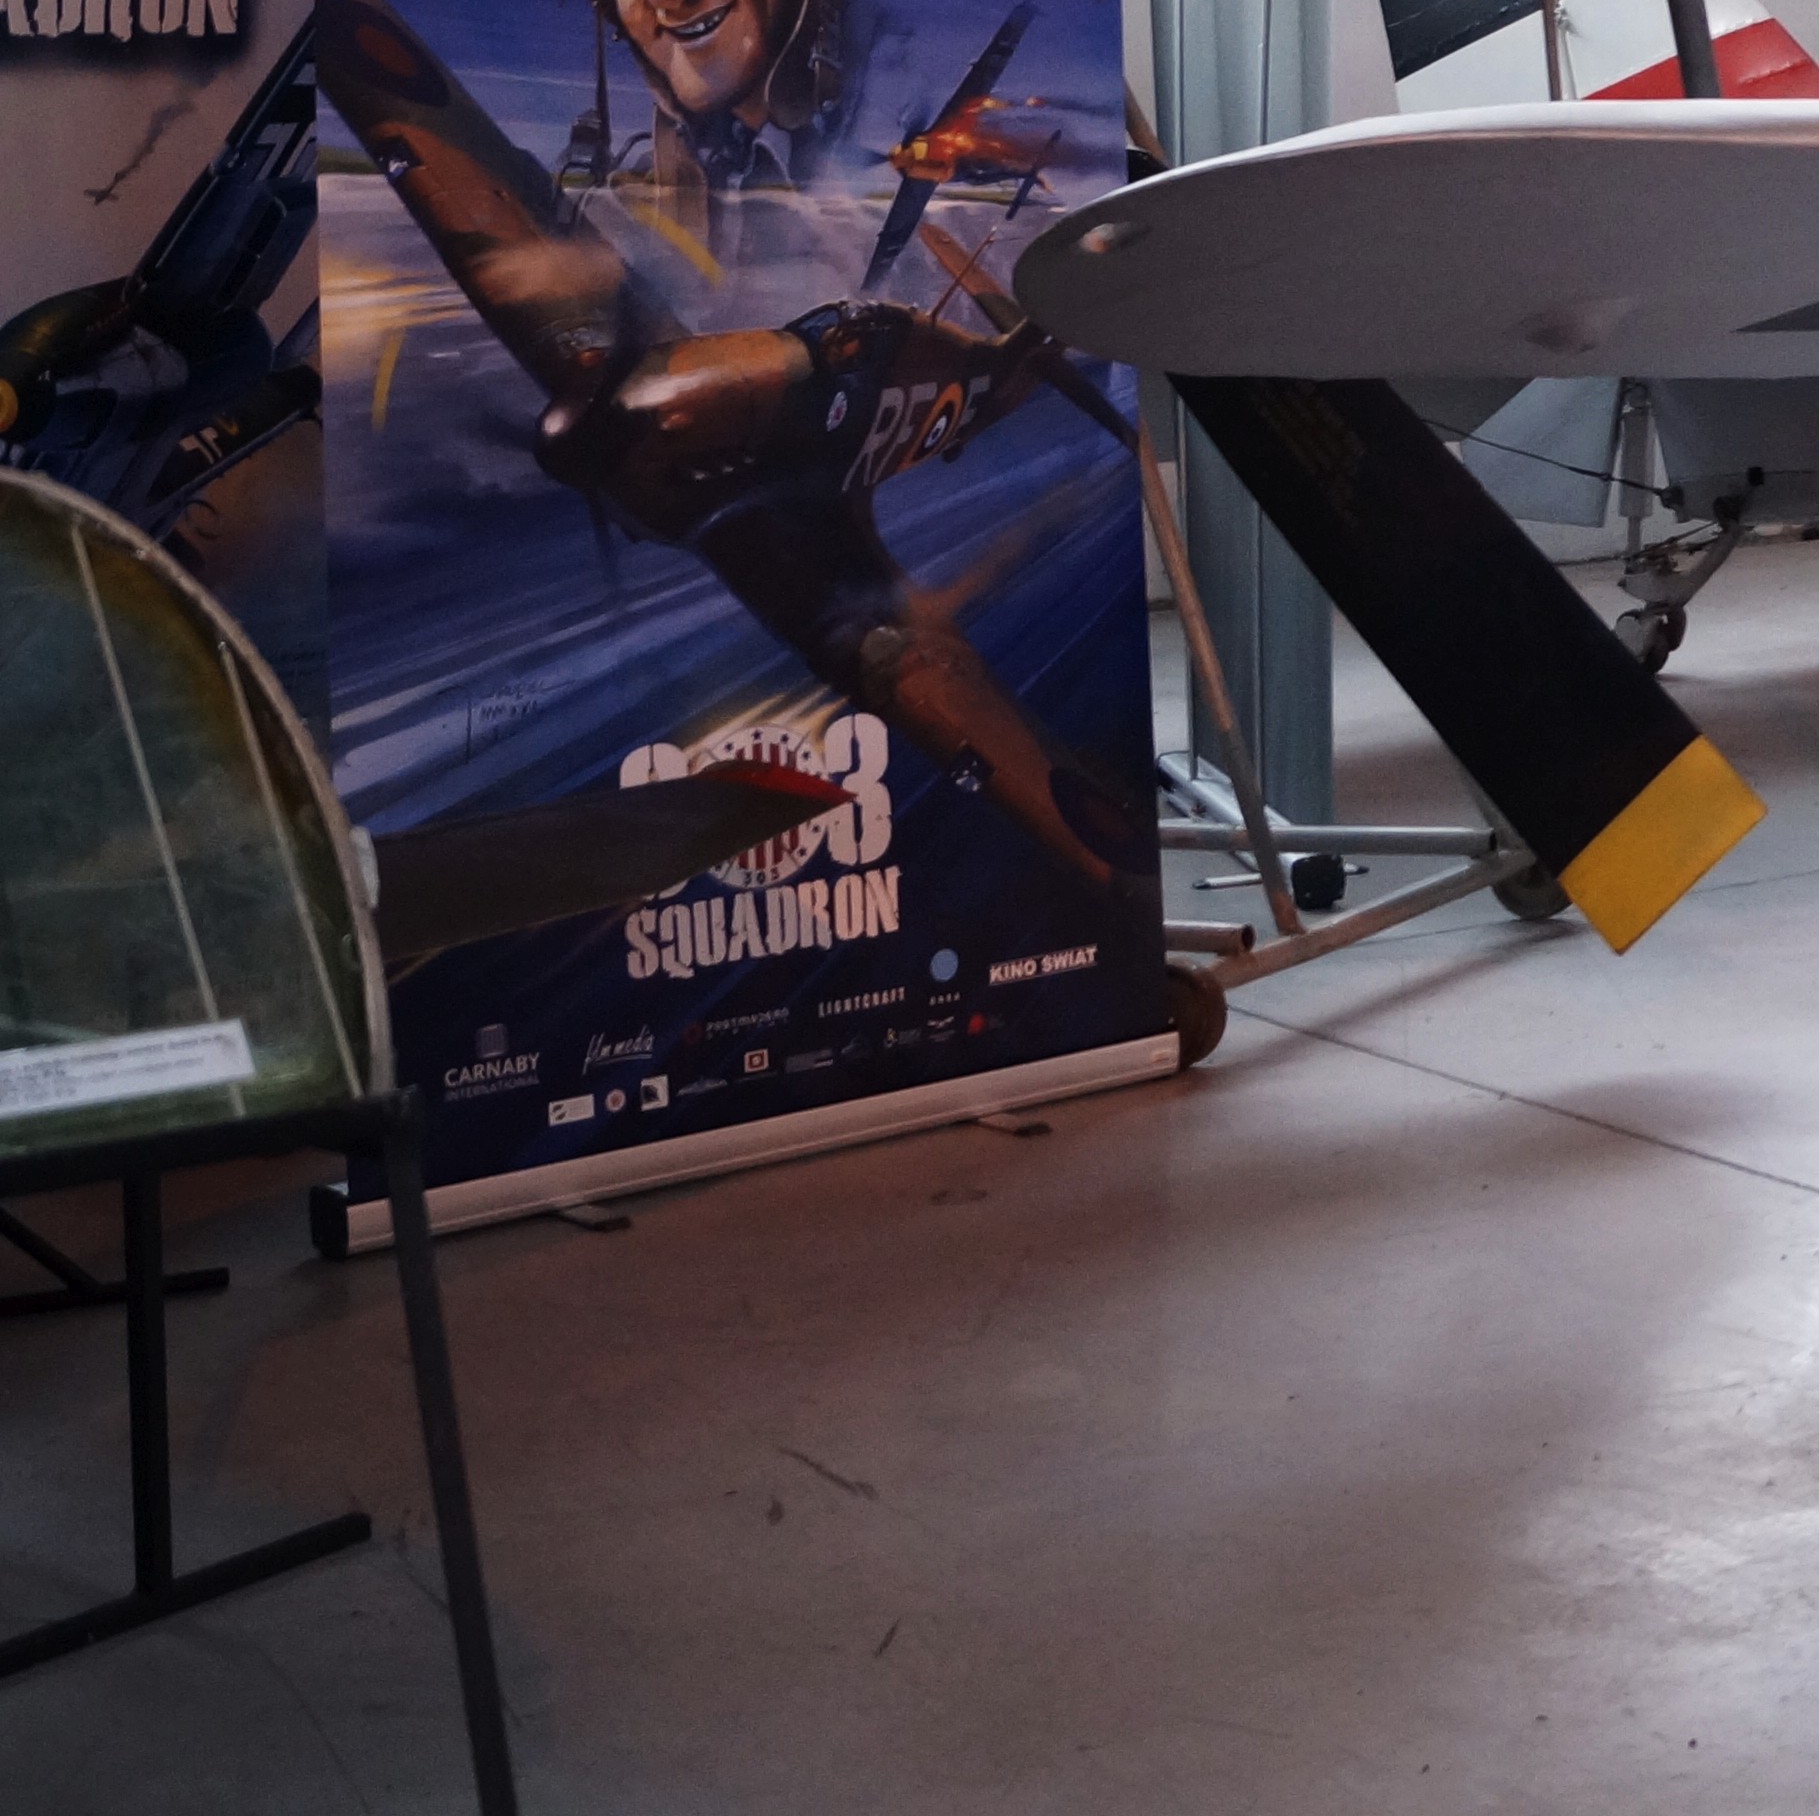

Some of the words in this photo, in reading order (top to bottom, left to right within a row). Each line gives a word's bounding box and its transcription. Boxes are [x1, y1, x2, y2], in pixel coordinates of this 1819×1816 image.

[623, 865, 904, 980] SQUADRON
[989, 958, 1037, 985] KINO
[443, 1051, 541, 1088] CARNABY
